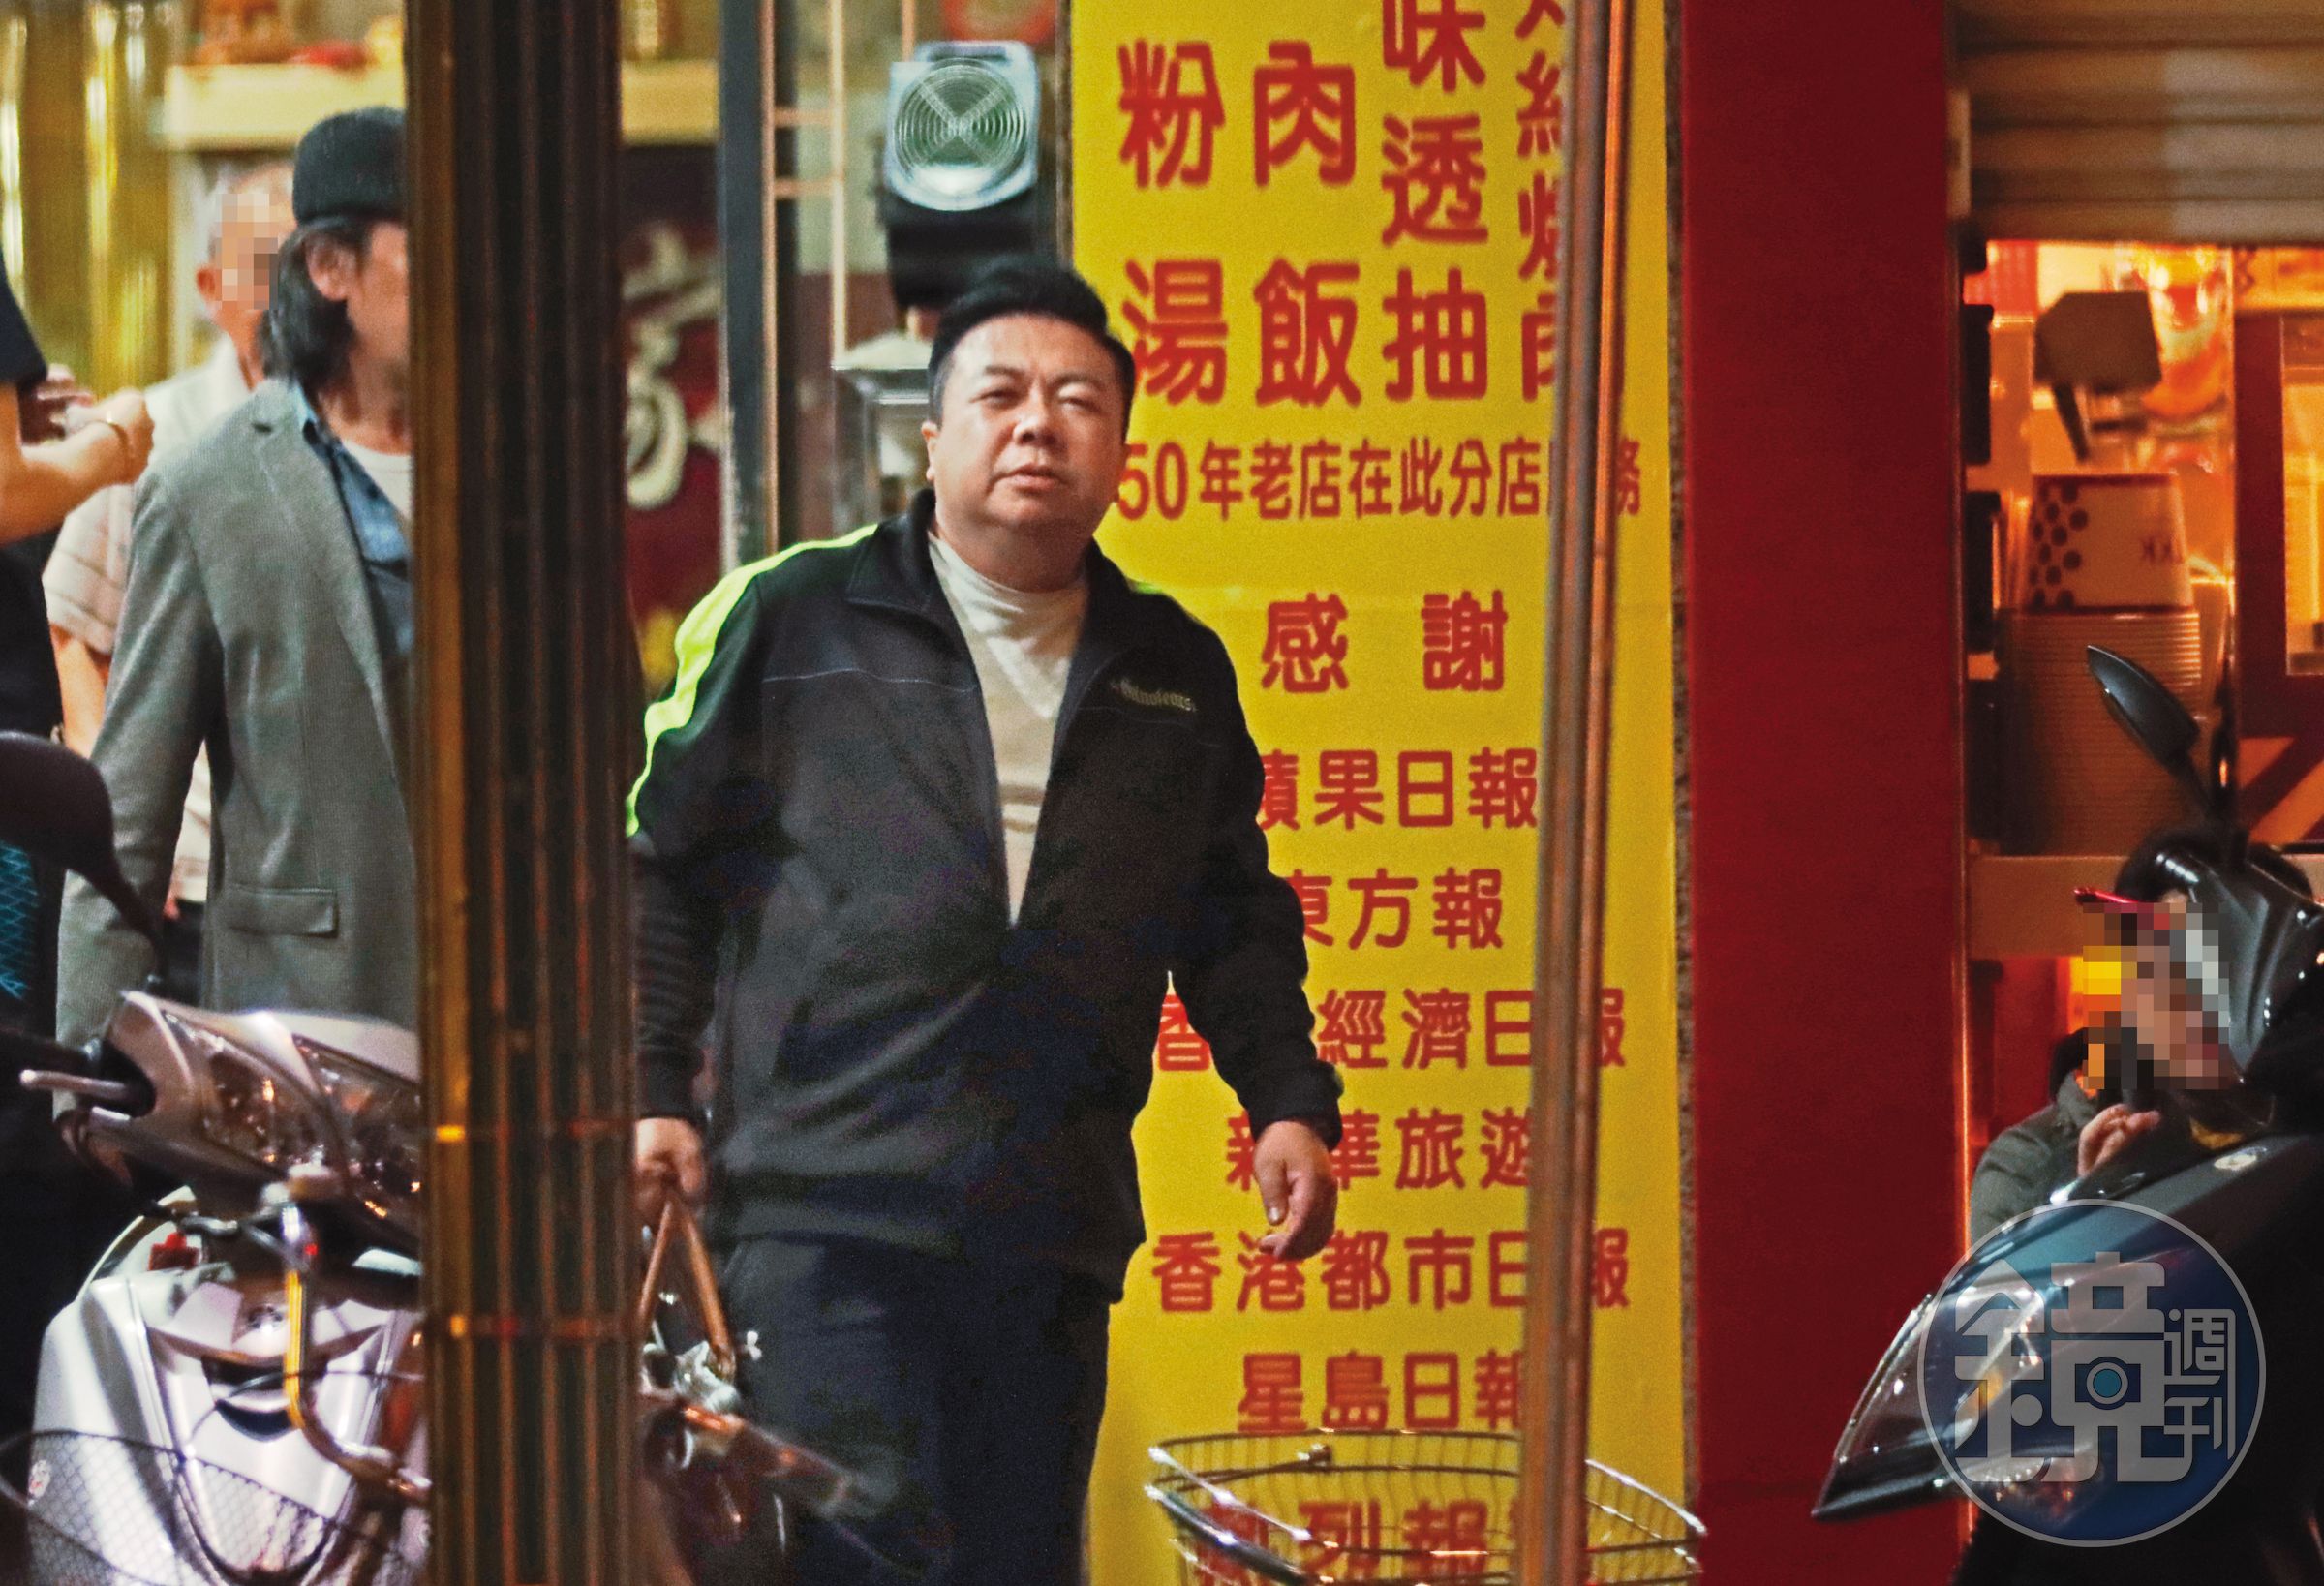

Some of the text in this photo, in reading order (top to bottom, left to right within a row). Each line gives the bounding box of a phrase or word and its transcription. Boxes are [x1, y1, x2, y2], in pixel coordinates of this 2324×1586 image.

[1253, 40, 1361, 408] 肉飯
[1382, 0, 1489, 402] 味透抽
[1118, 438, 1640, 521] 50年老店在此分店務
[1261, 590, 1508, 693] 感謝
[1238, 1350, 1521, 1434] 星島日報
